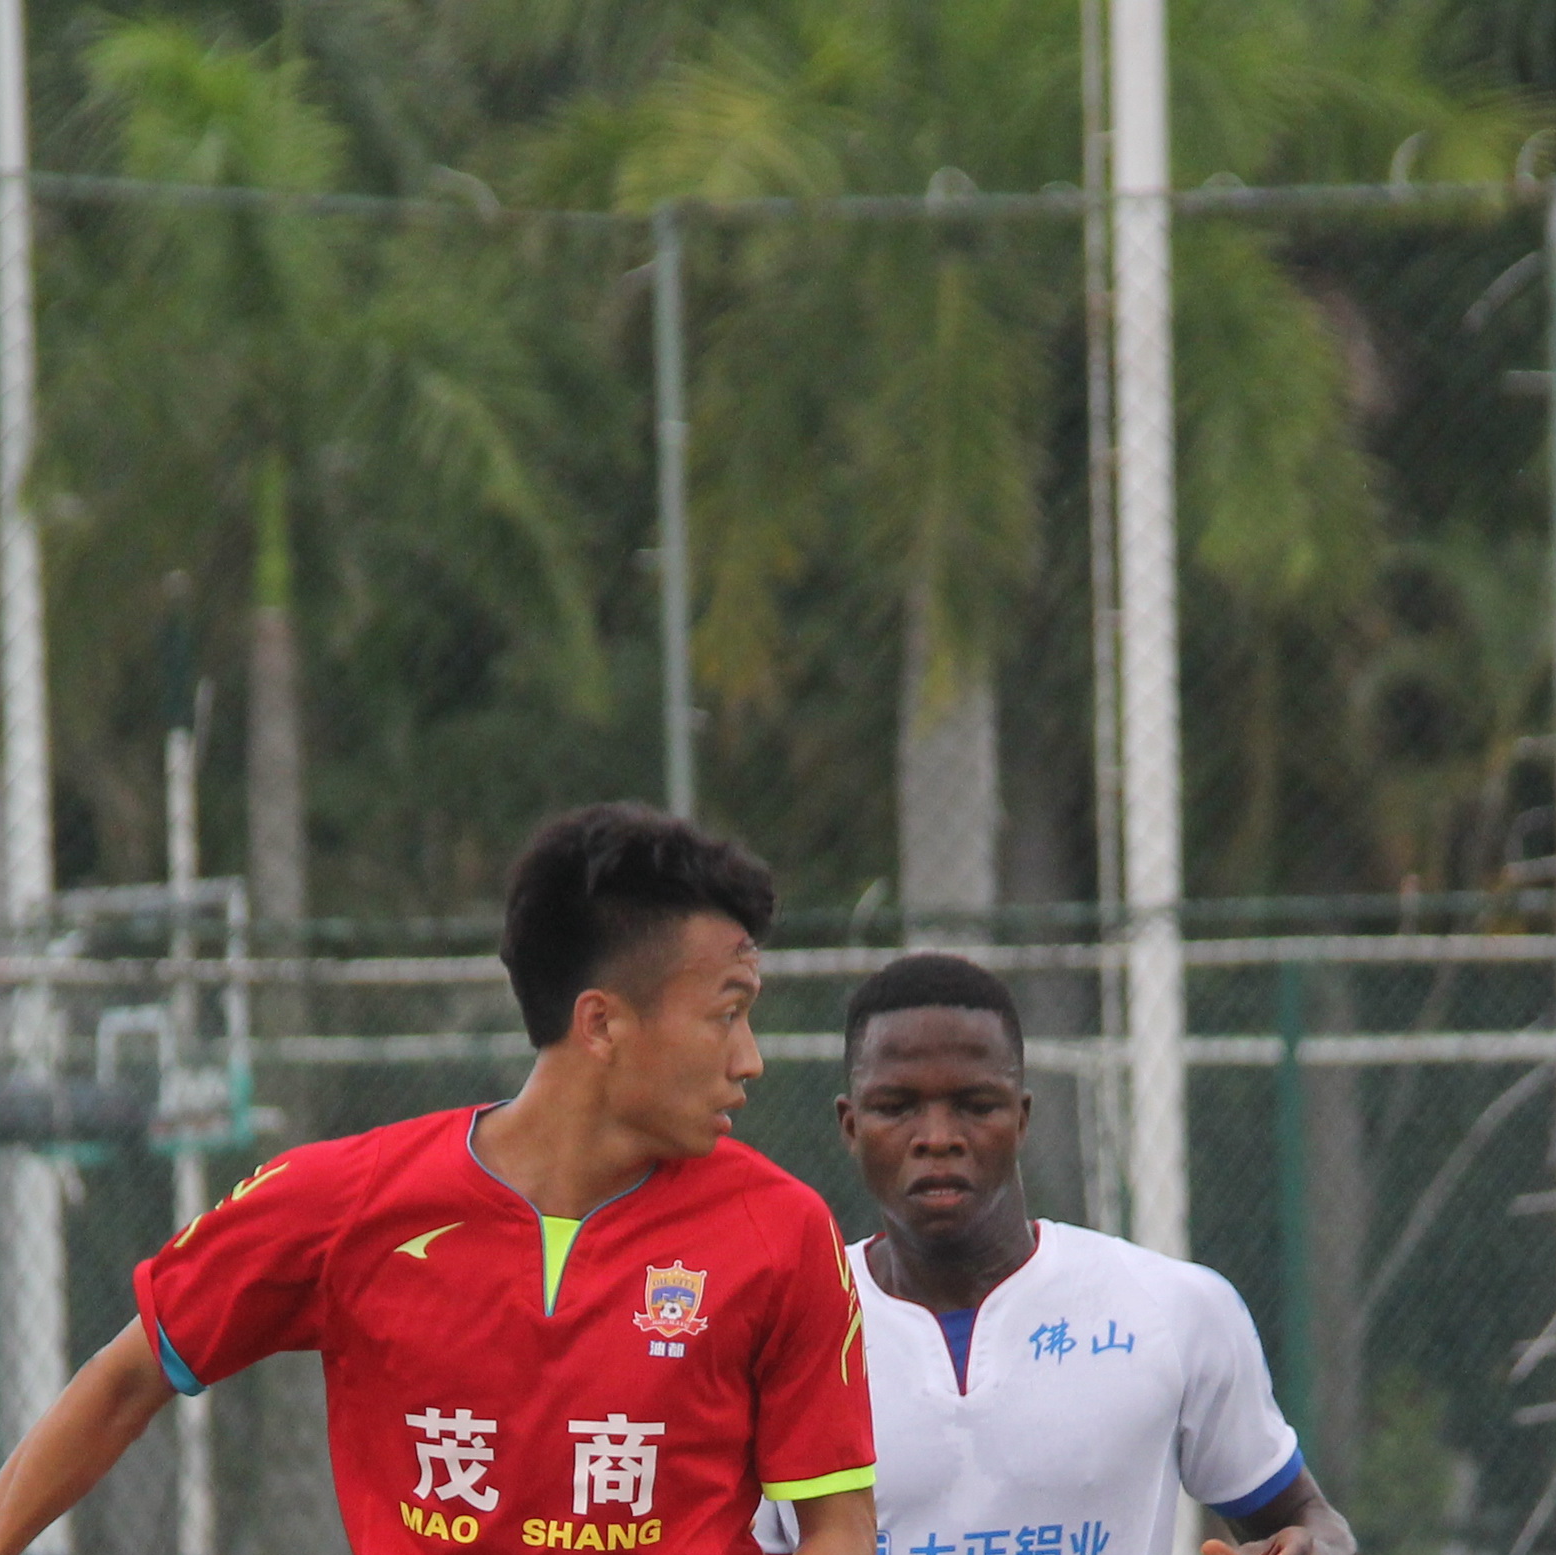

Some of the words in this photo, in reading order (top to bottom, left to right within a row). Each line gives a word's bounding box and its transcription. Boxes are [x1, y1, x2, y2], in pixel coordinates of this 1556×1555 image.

[1029, 1317, 1135, 1364] 佛山
[404, 1407, 666, 1517] 茂商
[399, 1501, 479, 1545] MAO
[521, 1517, 662, 1552] SHANG
